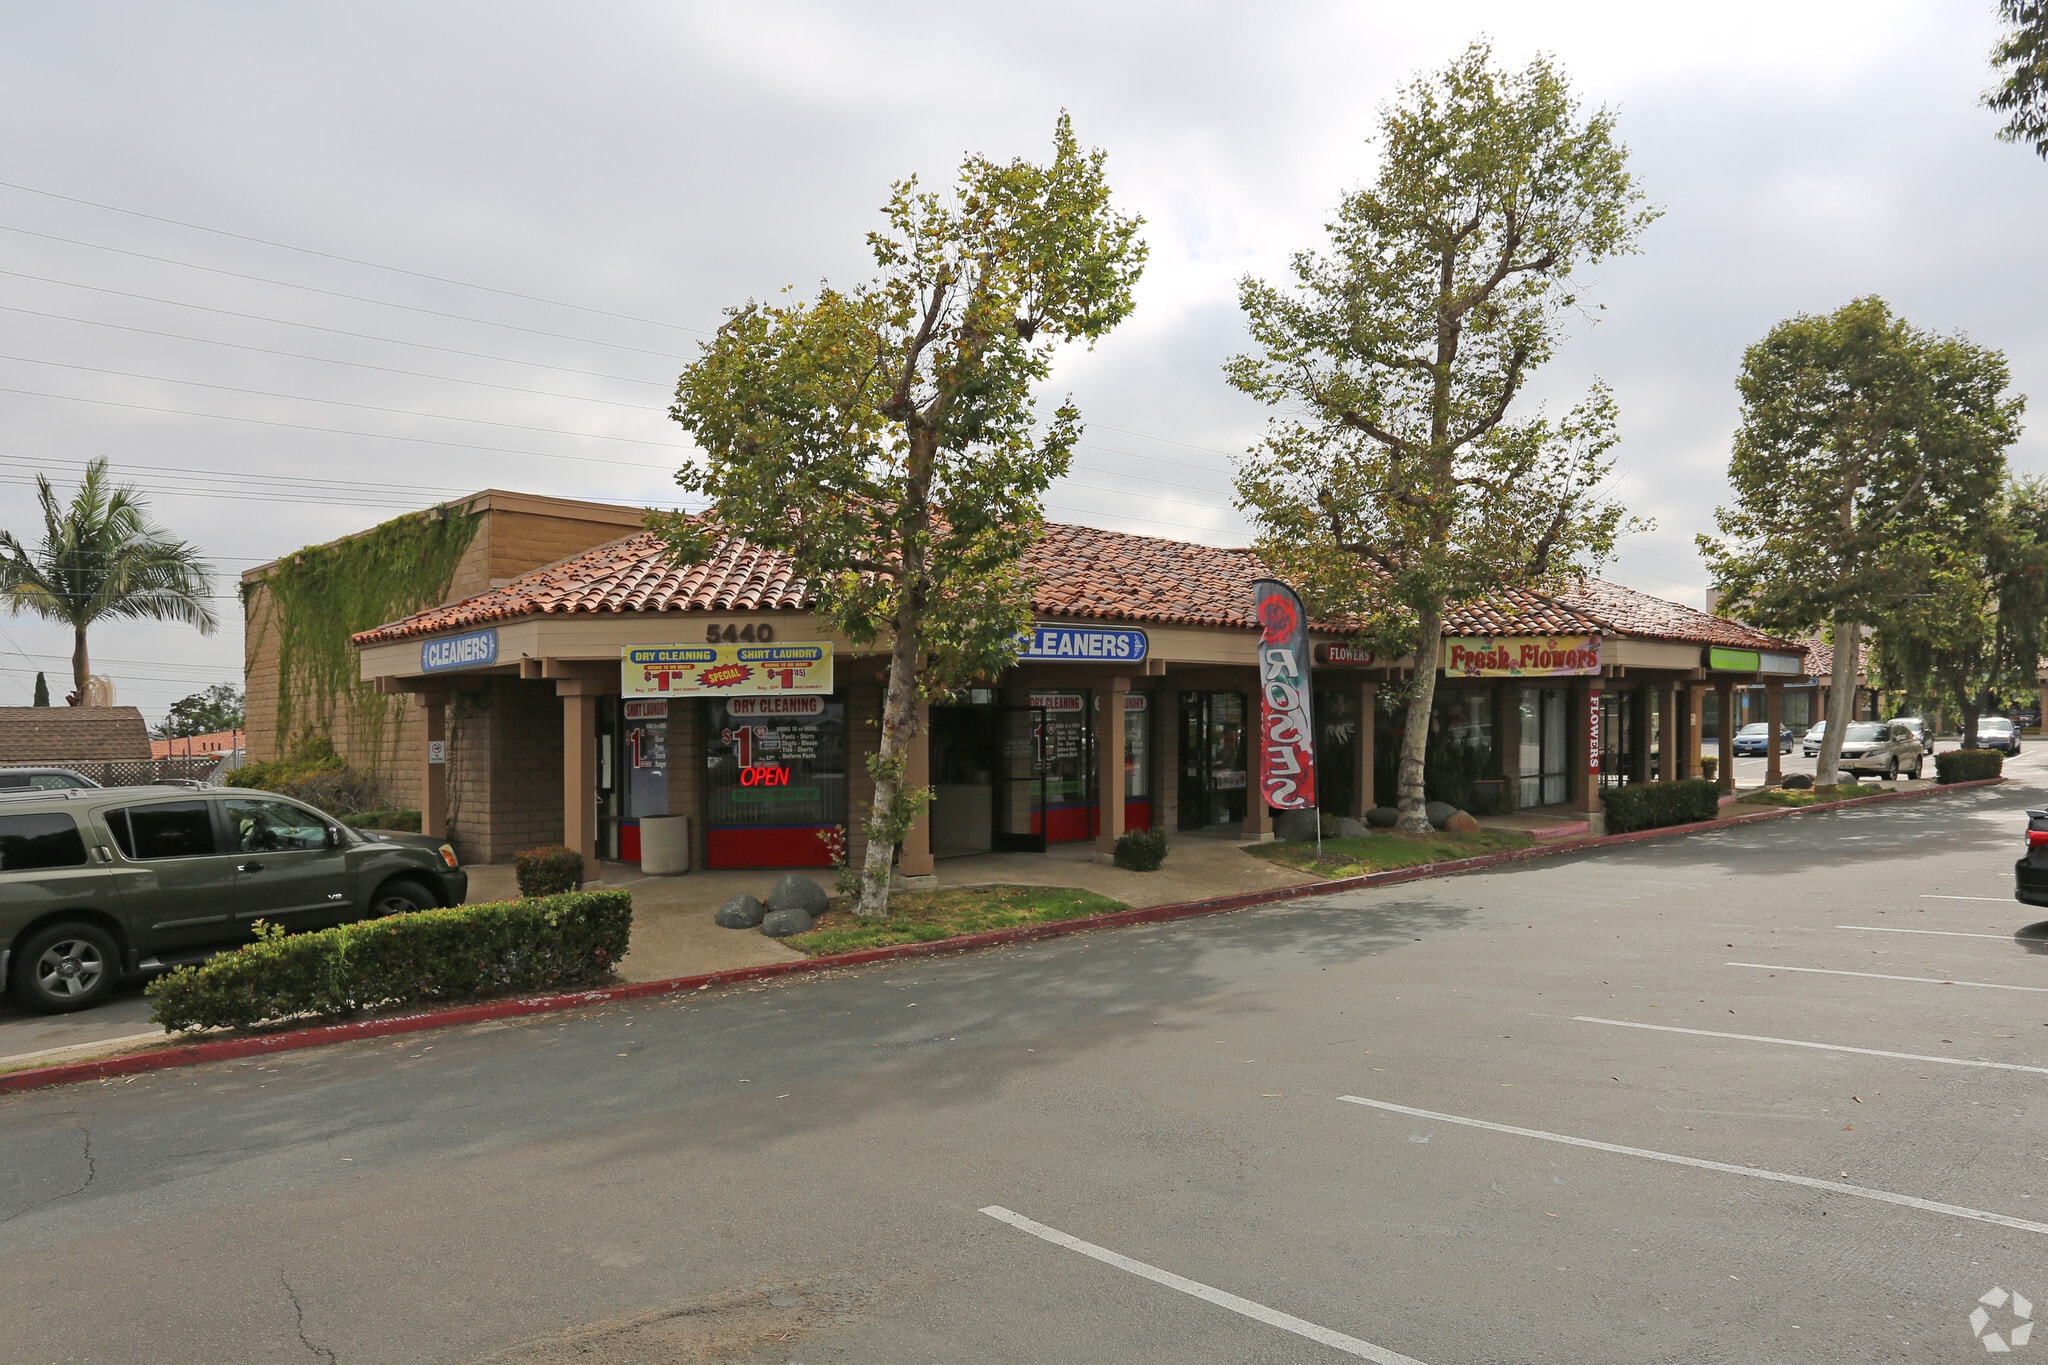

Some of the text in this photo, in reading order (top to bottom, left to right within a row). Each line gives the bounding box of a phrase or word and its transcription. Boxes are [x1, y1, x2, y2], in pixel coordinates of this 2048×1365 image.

[706, 623, 773, 643] 5440
[429, 635, 488, 667] CLEANERS
[635, 650, 711, 661] DRY CLEANING
[741, 648, 818, 659] SHIRT LAUNDRY
[1329, 647, 1370, 662] FLOWERS
[1451, 644, 1598, 670] Fresh Flowers
[708, 668, 742, 683] SPECIAL
[626, 702, 667, 717] SHIRT LAUNDRY
[734, 697, 817, 713] DRY CLEANING
[1046, 696, 1080, 710] CLEANING
[1125, 697, 1144, 709] UNDRY
[1589, 696, 1600, 768] FLOWERS
[741, 767, 790, 786] OPEN
